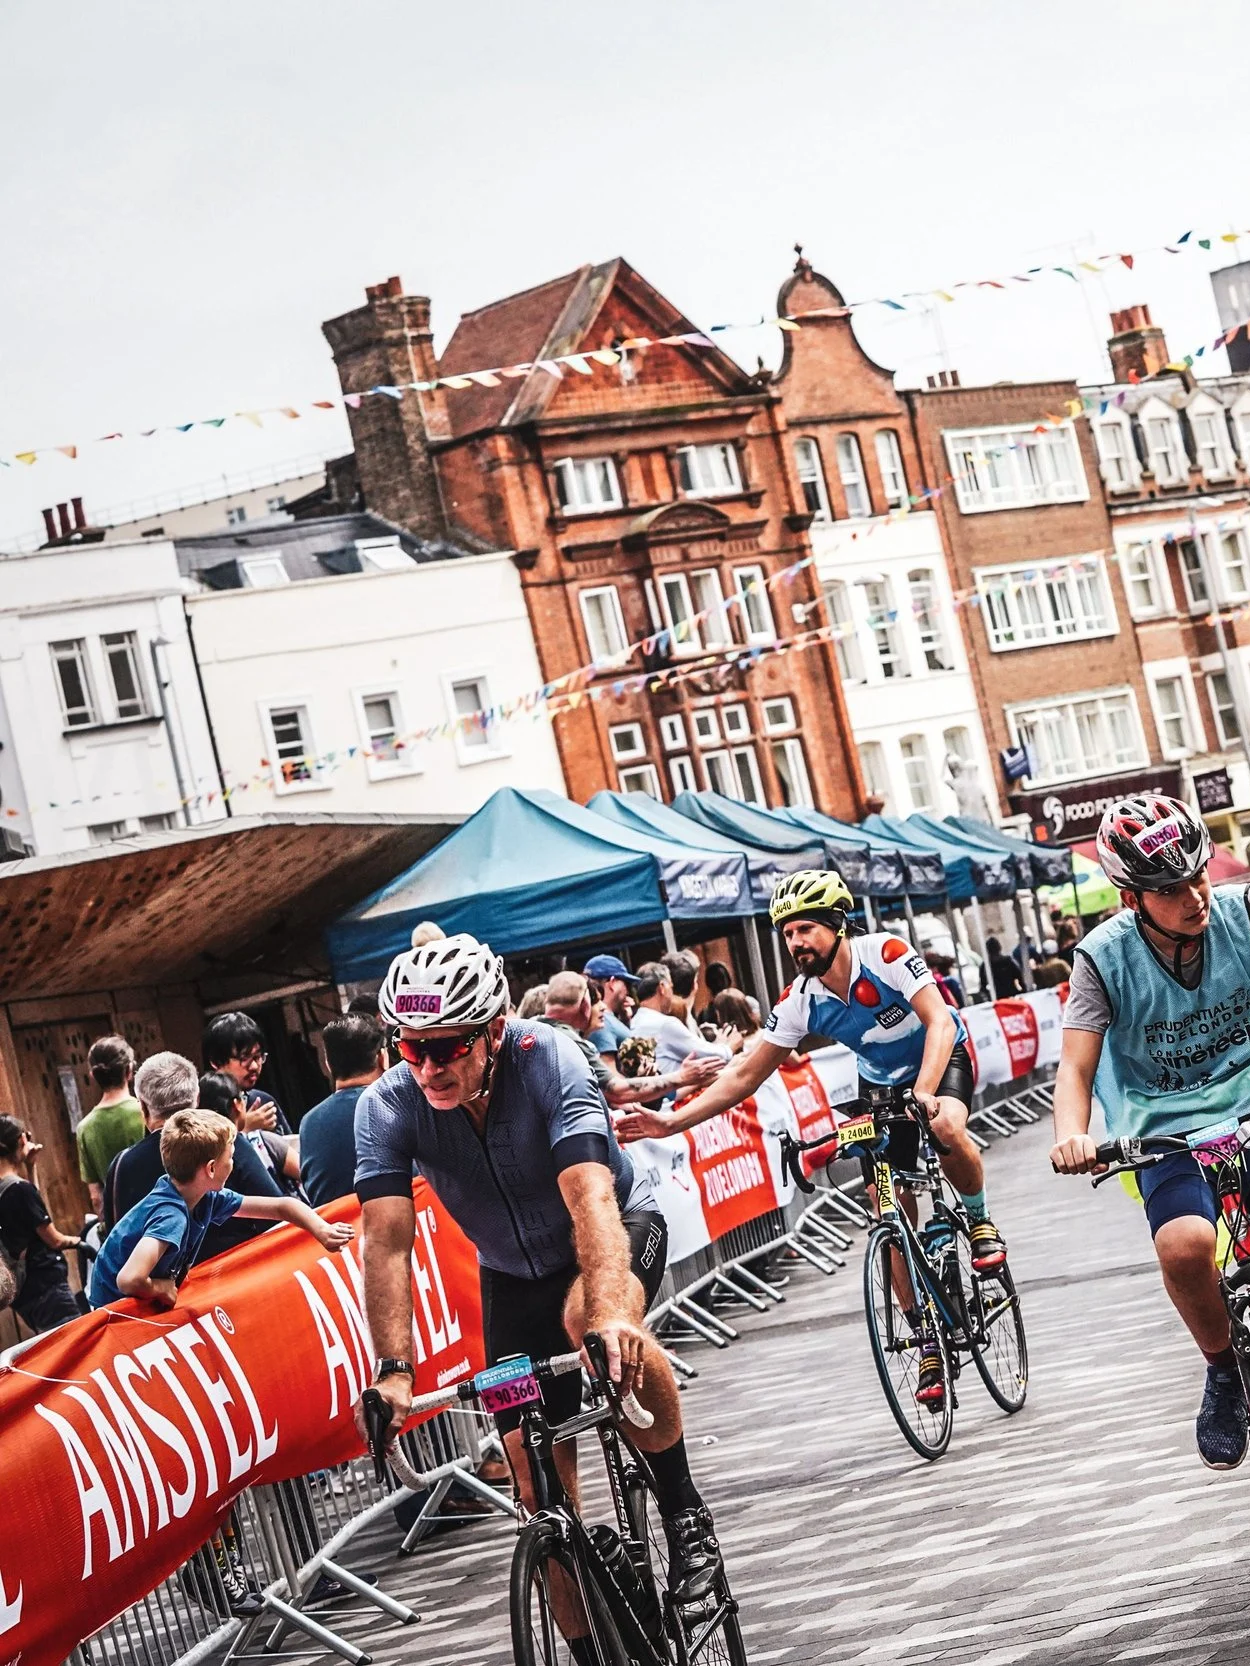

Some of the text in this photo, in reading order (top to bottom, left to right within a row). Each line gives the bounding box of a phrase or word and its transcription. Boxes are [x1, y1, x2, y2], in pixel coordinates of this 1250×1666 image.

[400, 994, 436, 1013] 90366
[880, 1009, 904, 1025] Lung
[1144, 1001, 1231, 1035] PRUDENTIAL
[1149, 1043, 1202, 1057] LONDON
[840, 1133, 845, 1141] B
